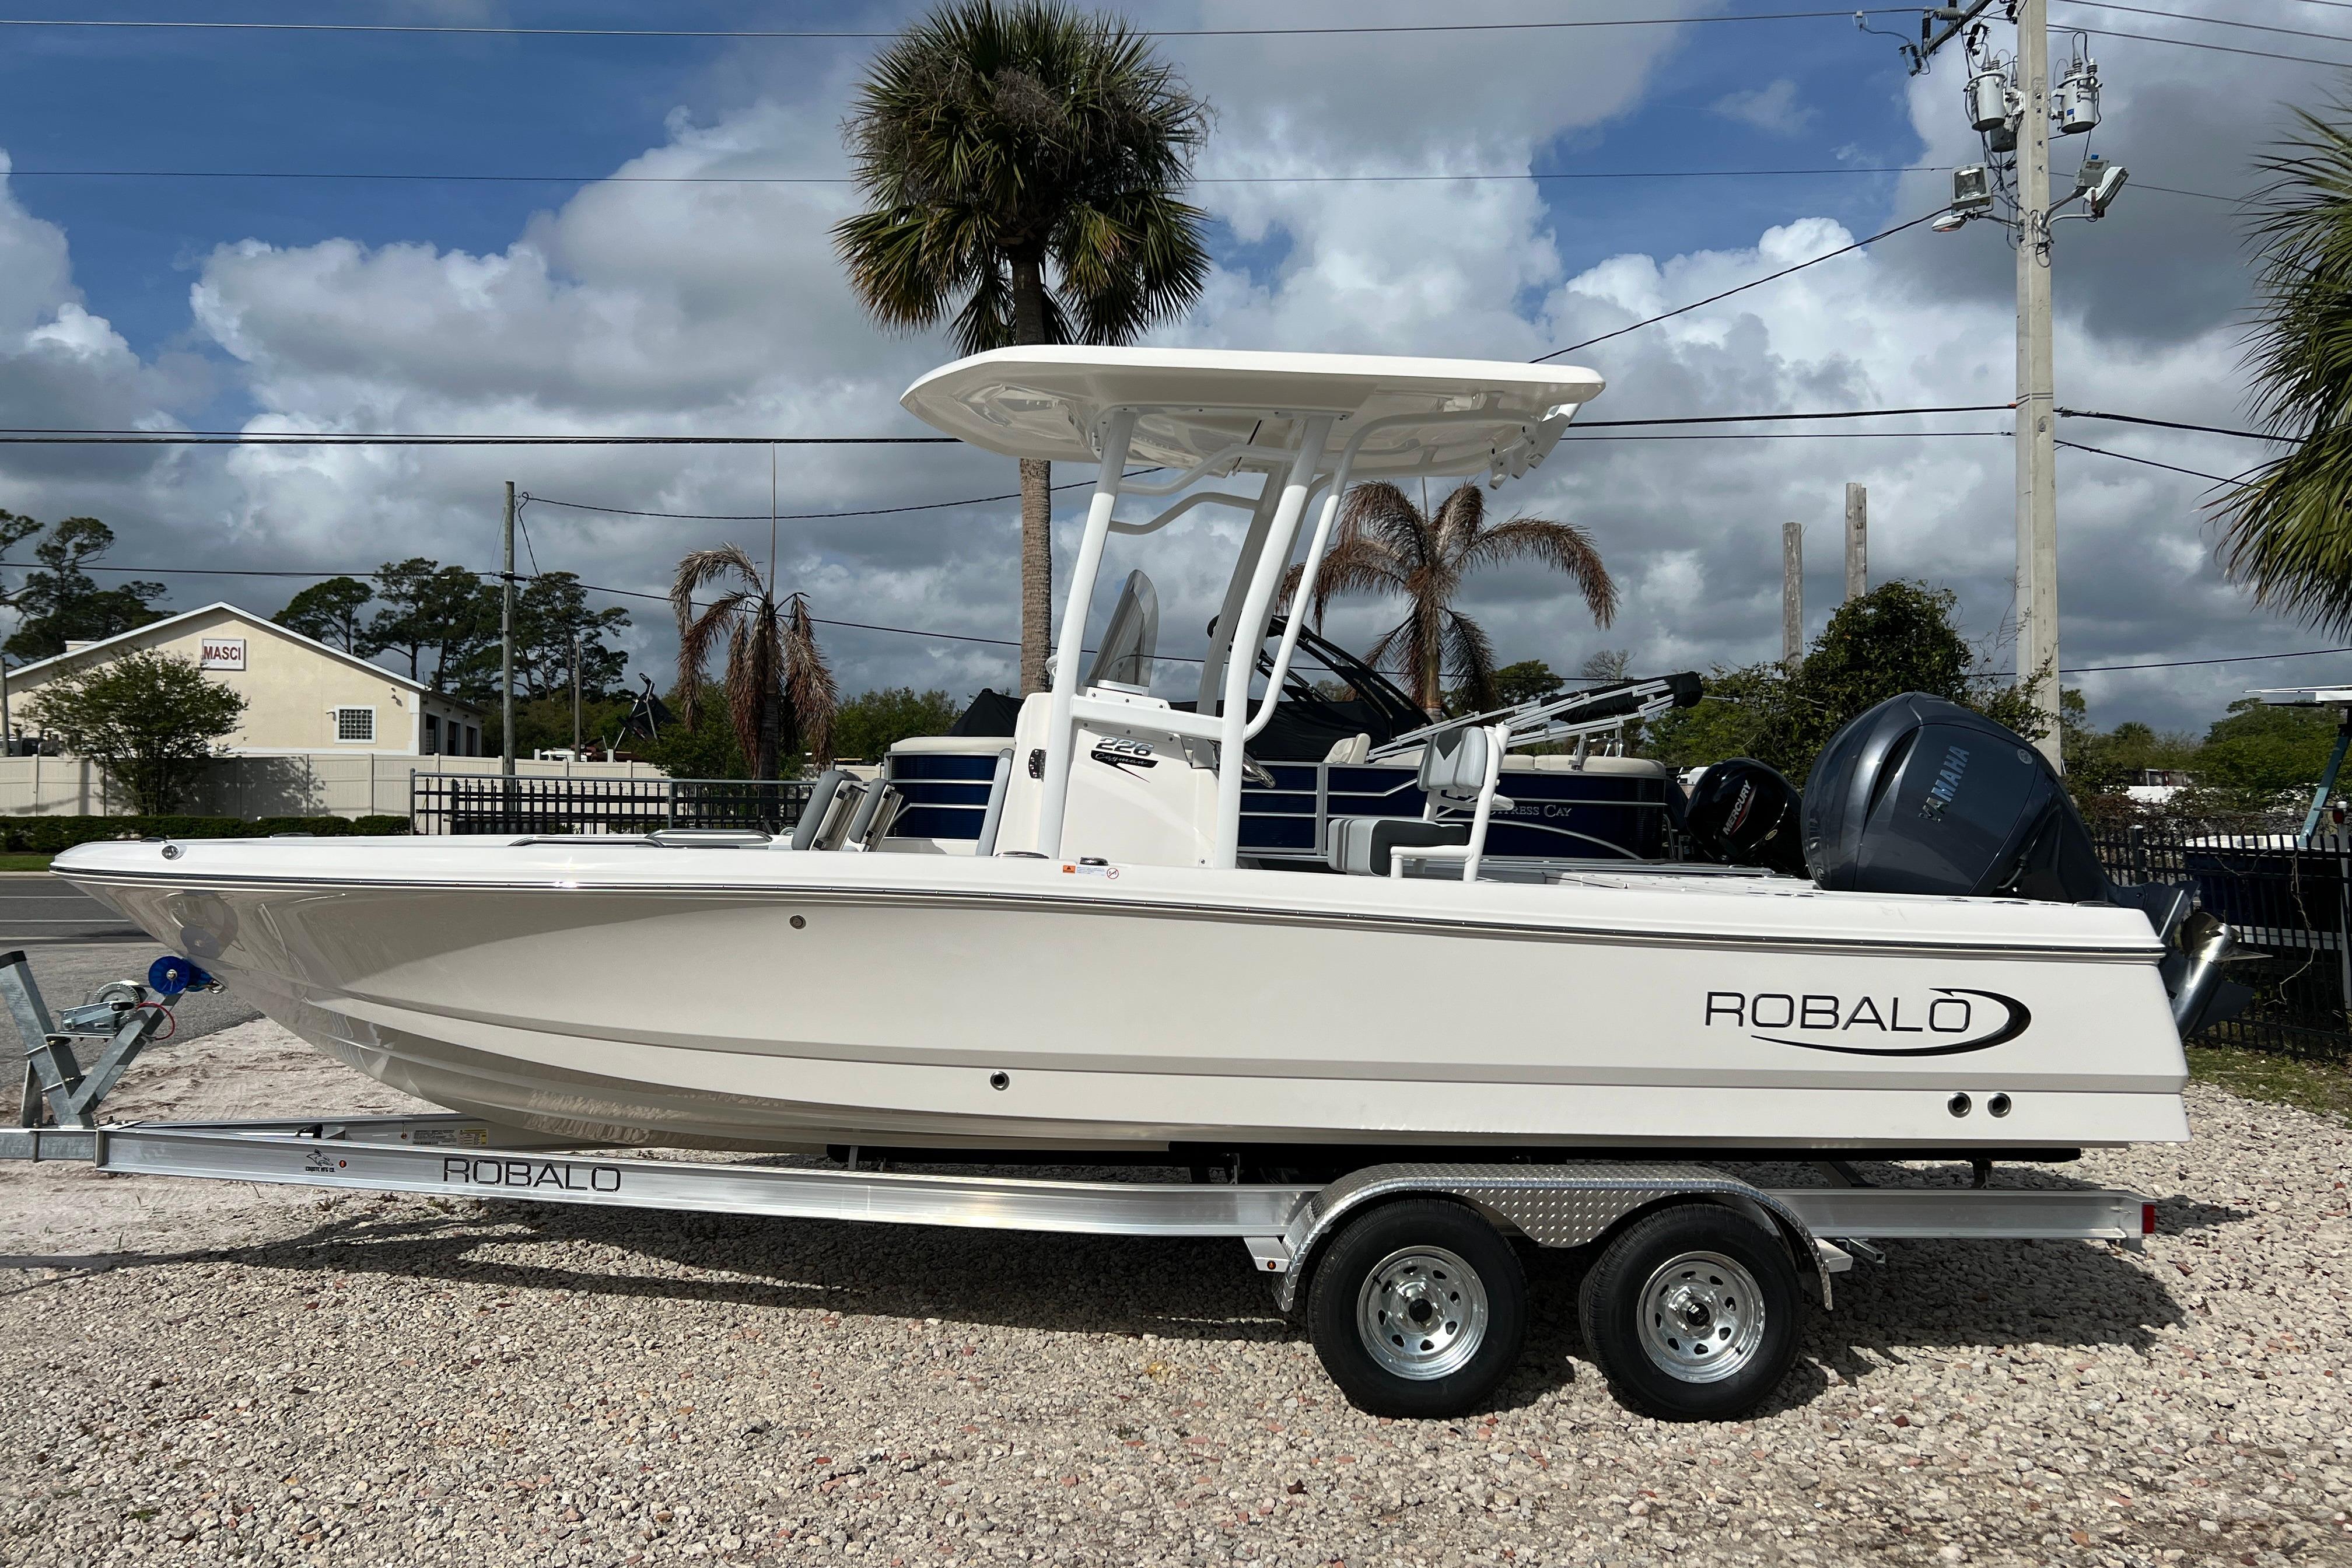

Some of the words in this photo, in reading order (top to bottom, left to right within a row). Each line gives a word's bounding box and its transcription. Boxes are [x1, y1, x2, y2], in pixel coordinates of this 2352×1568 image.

[204, 646, 241, 660] MASCI
[1095, 752, 1149, 765] Cayman
[1096, 736, 1155, 757] 226
[1918, 746, 1970, 823] YAMAHA
[1722, 779, 1751, 835] MERCURY
[1704, 991, 1972, 1033] ROBALO
[443, 1157, 622, 1192] ROBALO
